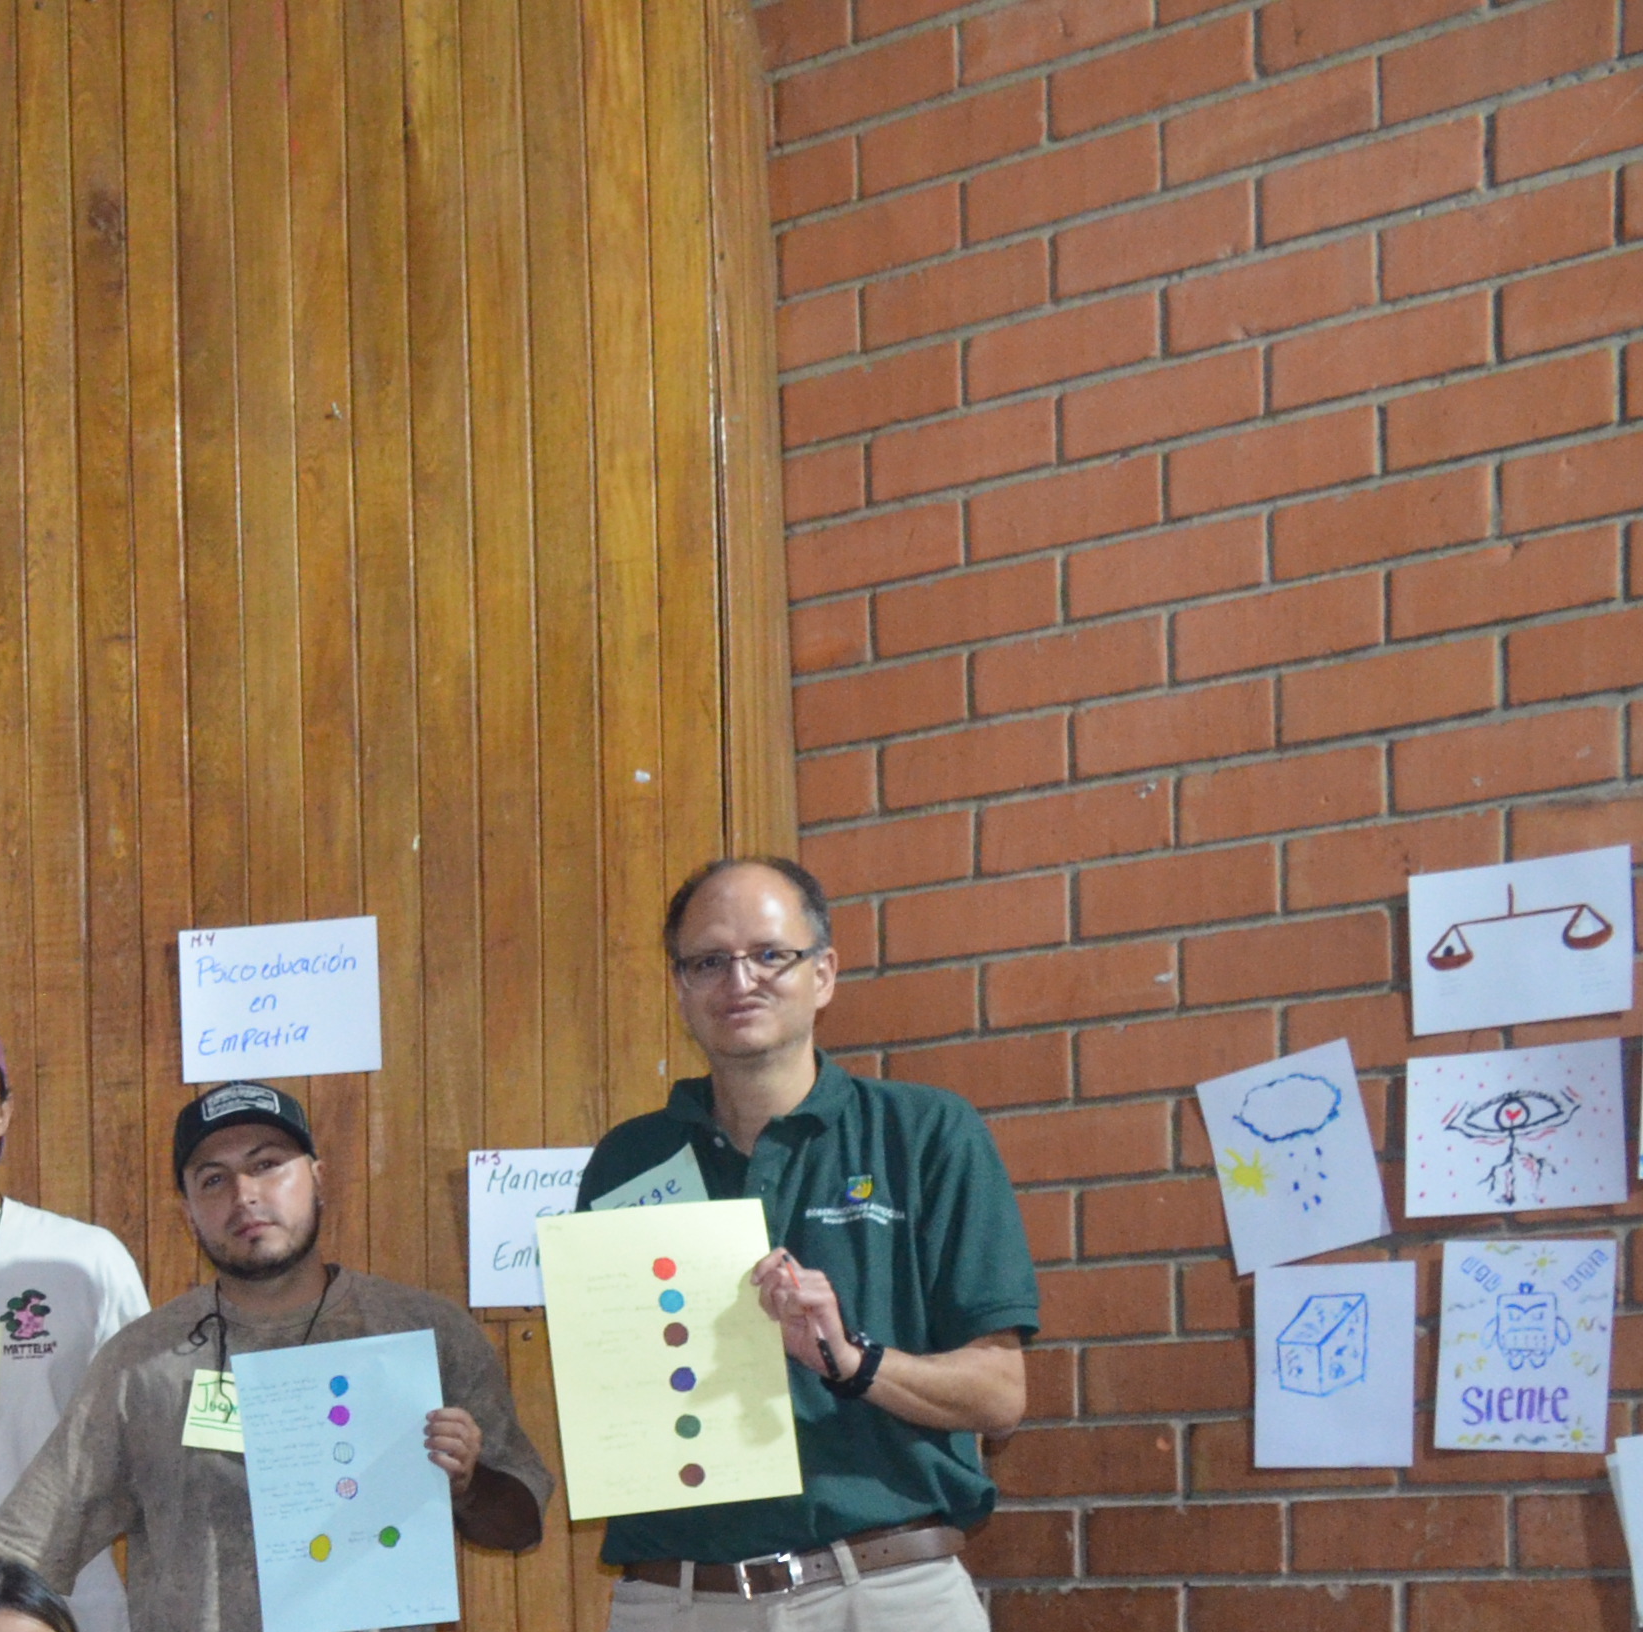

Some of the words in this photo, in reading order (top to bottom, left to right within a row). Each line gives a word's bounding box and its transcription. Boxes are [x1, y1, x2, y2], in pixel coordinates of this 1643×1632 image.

[196, 942, 357, 987] Psicoeducación
[248, 992, 277, 1014] en
[198, 1021, 310, 1056] Empatía
[486, 1163, 583, 1194] Maneras
